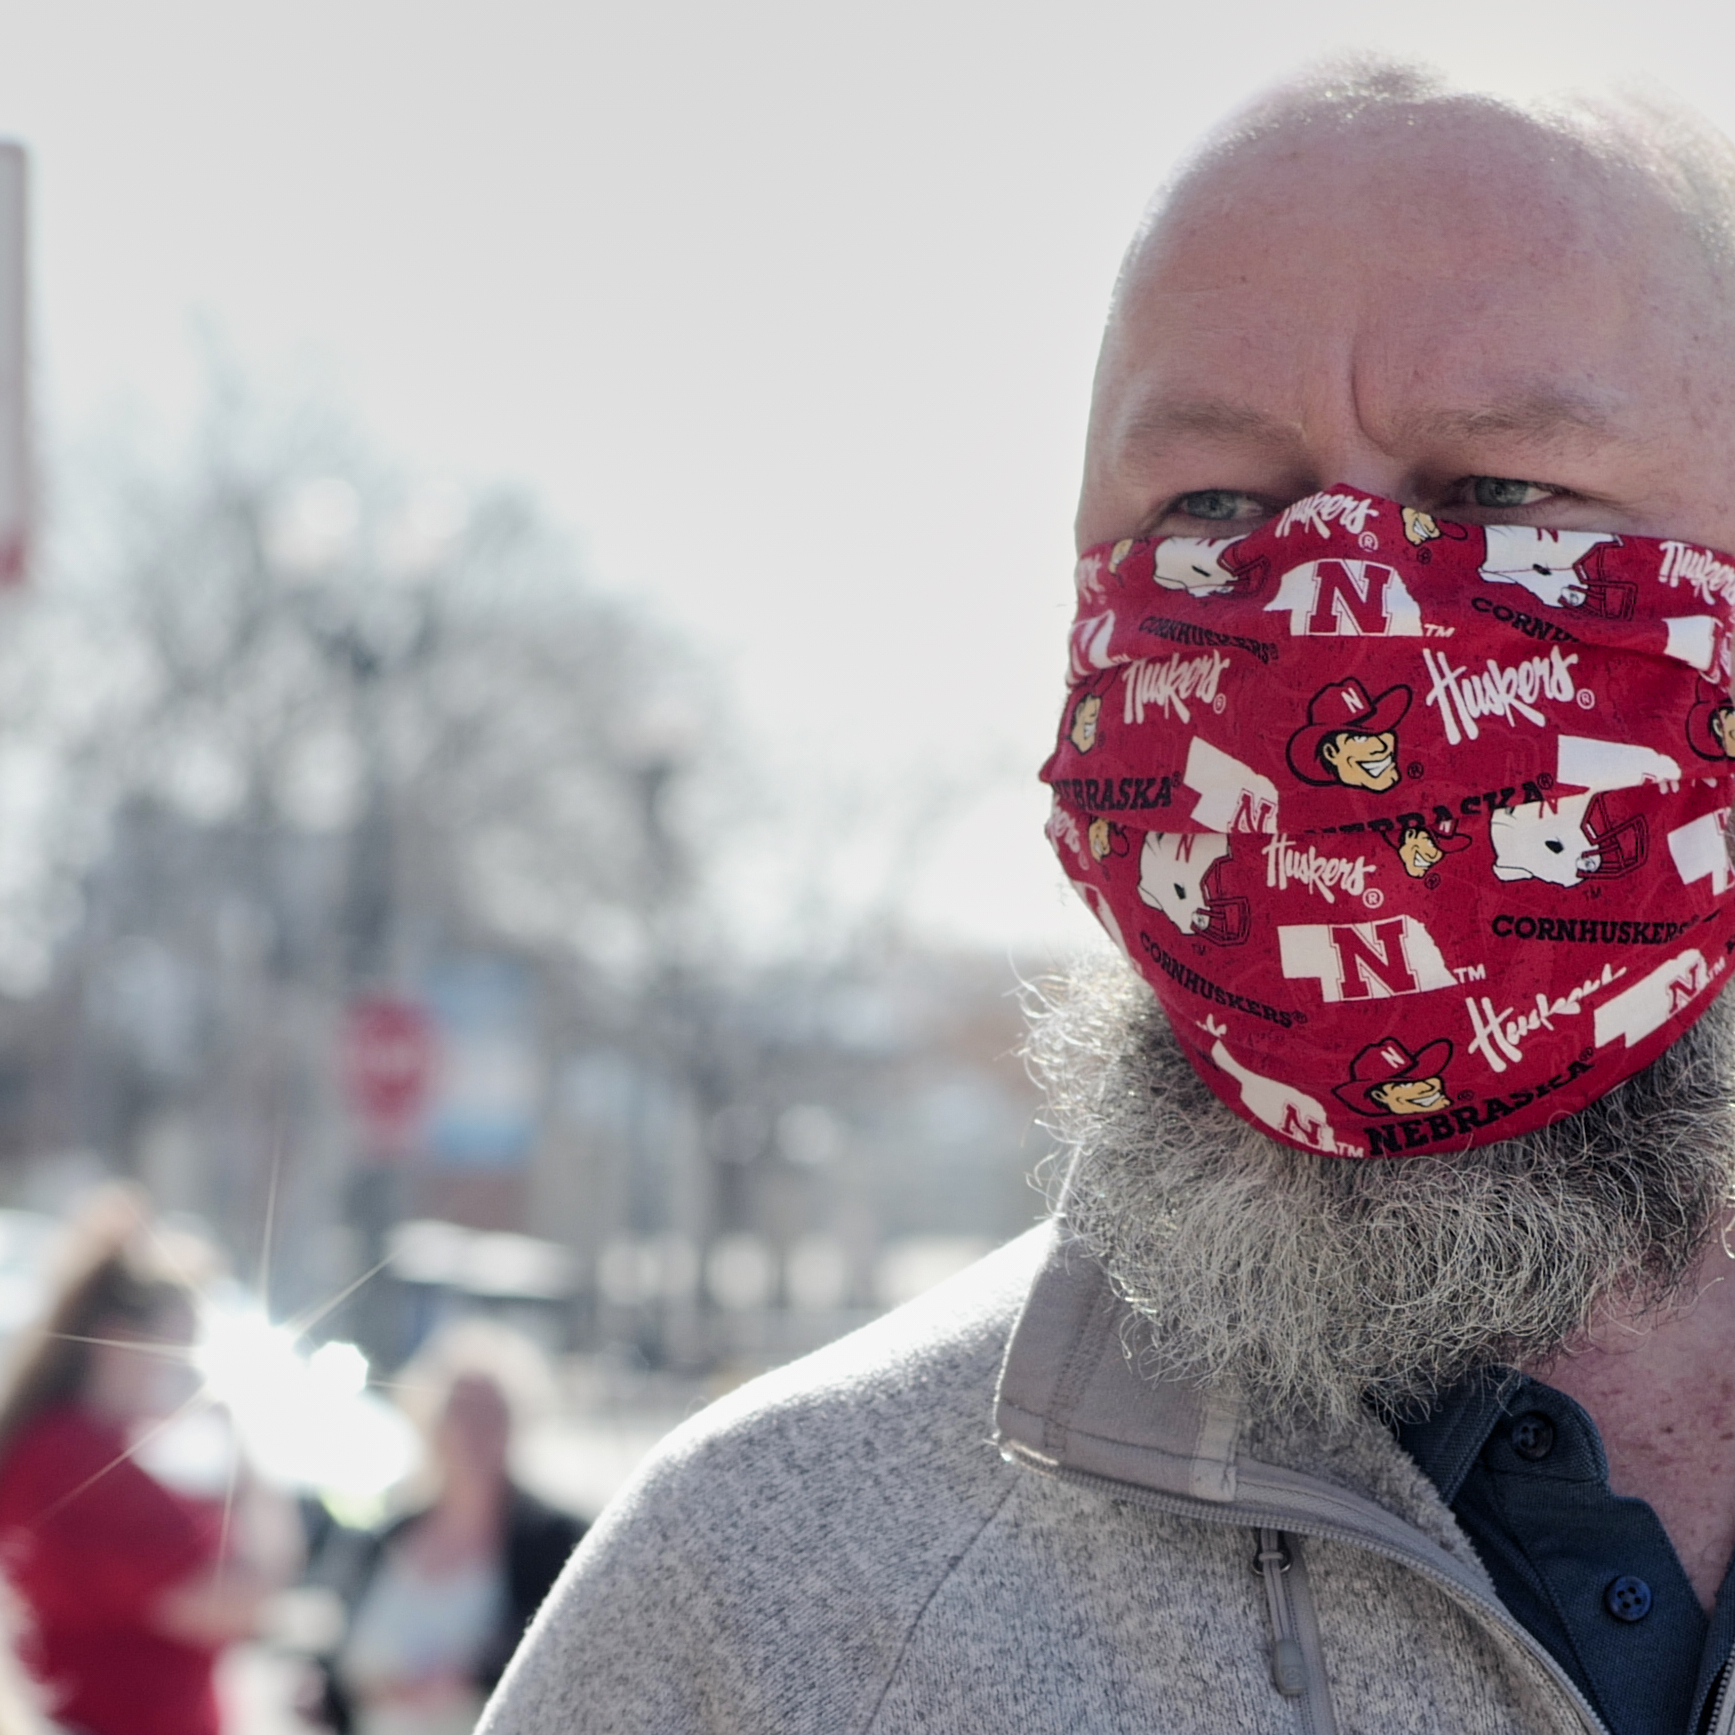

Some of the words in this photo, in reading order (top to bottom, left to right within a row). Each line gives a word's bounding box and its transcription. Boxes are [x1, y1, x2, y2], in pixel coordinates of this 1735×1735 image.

[1305, 558, 1396, 637] N
[1423, 623, 1456, 638] TM
[1122, 649, 1230, 724] Huskers
[1423, 645, 1579, 745] Huskers
[1262, 832, 1377, 904] Huskers
[1329, 914, 1422, 1001] N
[1453, 963, 1486, 984] TM
